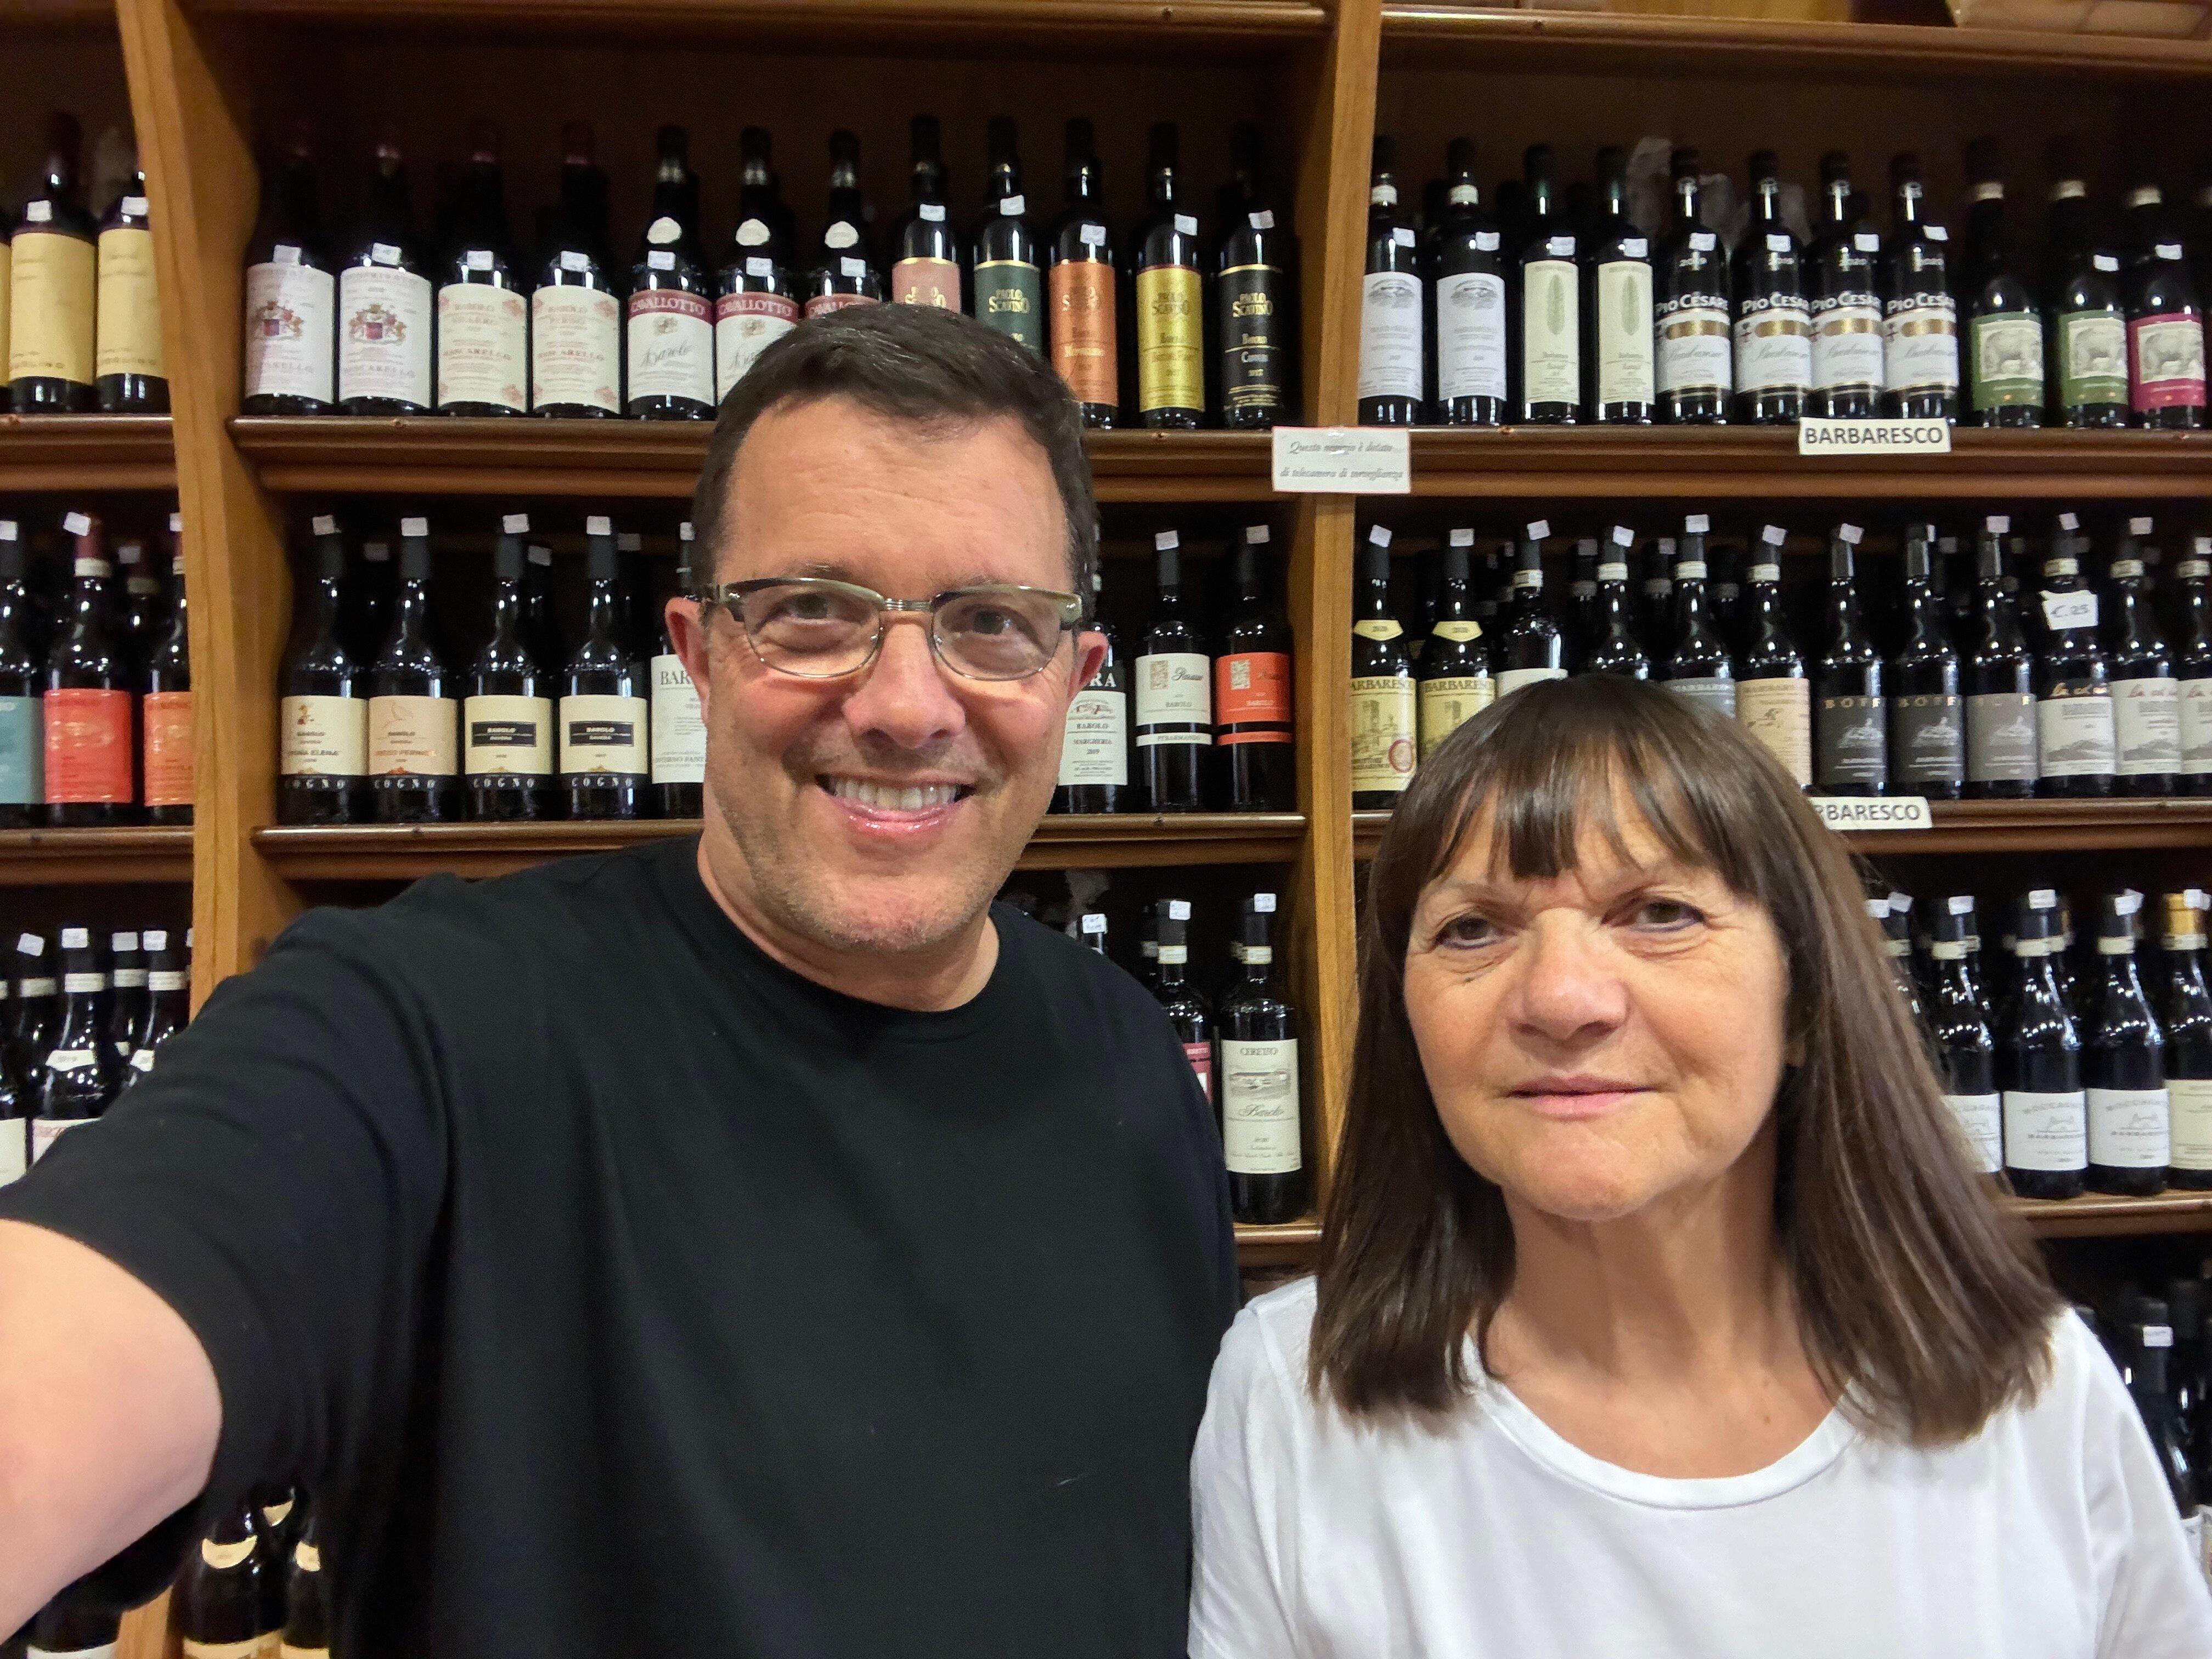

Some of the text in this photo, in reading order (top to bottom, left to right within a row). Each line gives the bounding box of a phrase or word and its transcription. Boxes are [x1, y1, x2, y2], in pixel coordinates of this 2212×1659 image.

[631, 297, 706, 315] CAVALLOTTO
[718, 300, 793, 317] CAVALLOTTO
[1742, 298, 1769, 314] PIO
[1887, 298, 1915, 314] PIO
[1805, 427, 1942, 444] BARBARESCO
[660, 670, 690, 685] BAR
[1089, 673, 1117, 687] RA
[1815, 804, 1920, 821] BARESCO
